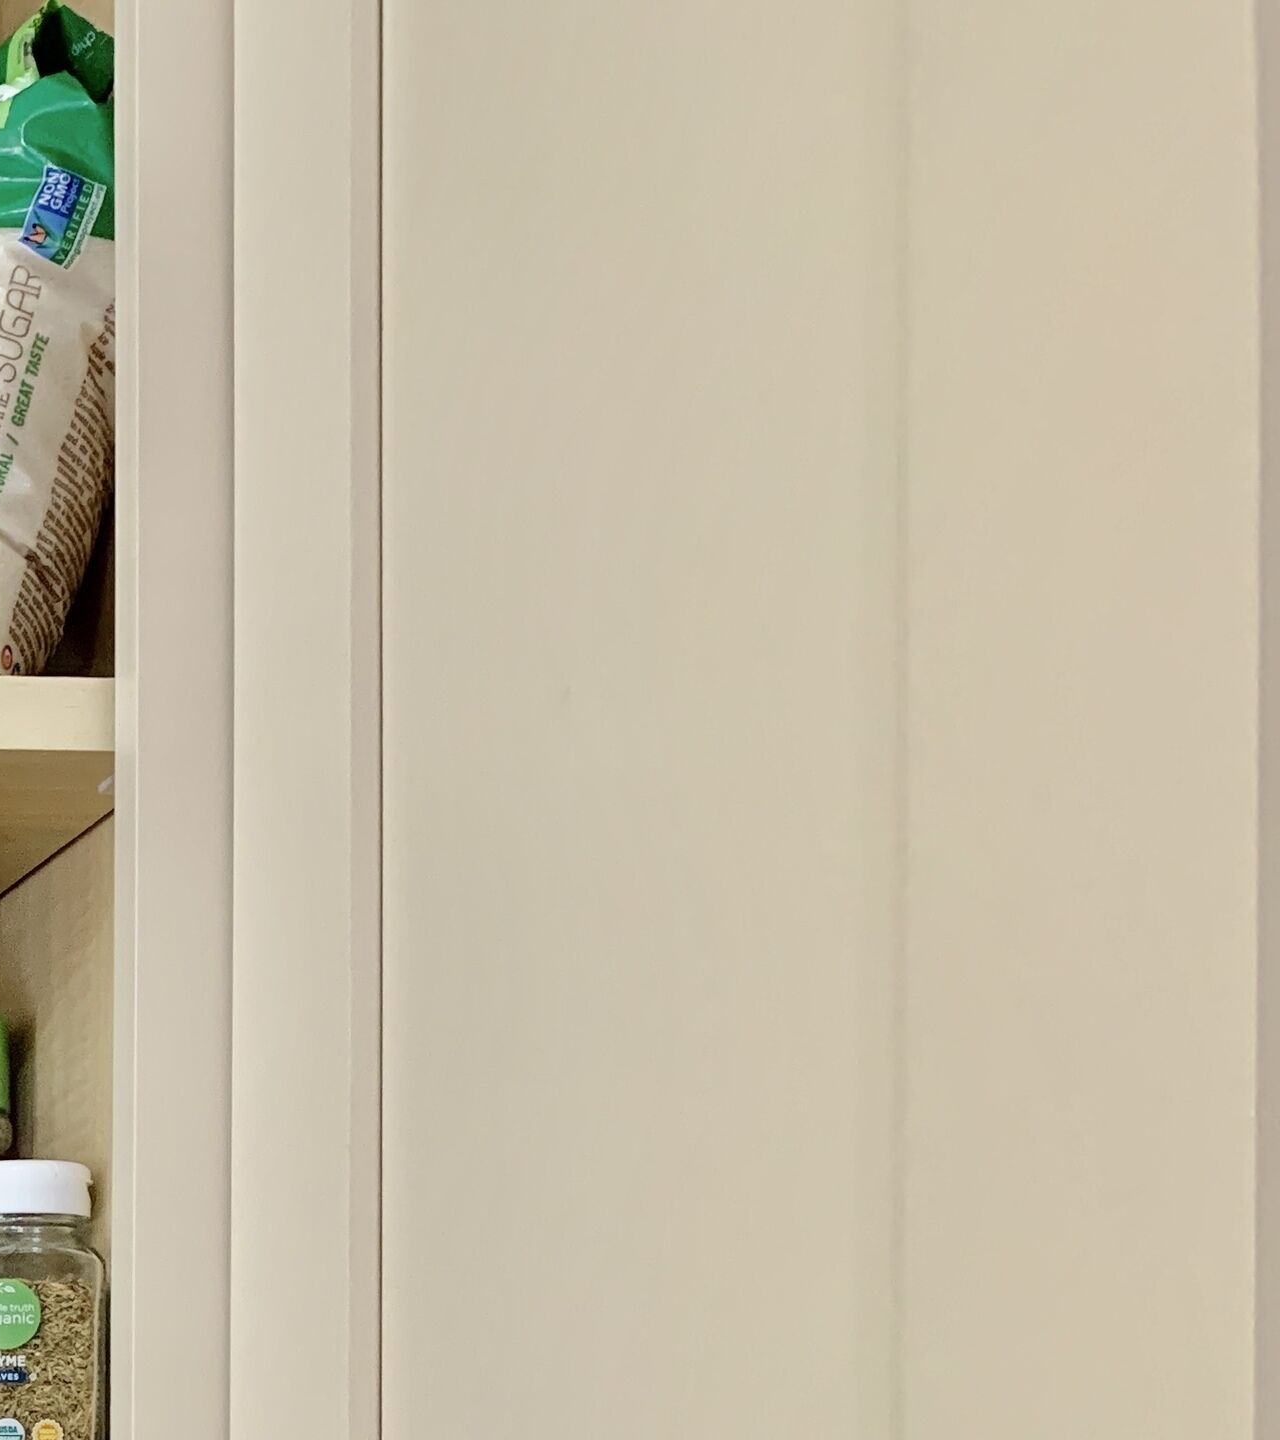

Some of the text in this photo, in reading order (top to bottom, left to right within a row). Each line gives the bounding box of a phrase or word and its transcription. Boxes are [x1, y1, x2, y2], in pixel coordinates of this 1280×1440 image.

[39, 172, 59, 206] NON
[50, 173, 71, 210] GMO
[56, 184, 92, 260] VERIFIED
[11, 379, 35, 428] GREAT
[26, 332, 50, 380] TASTE
[10, 1304, 34, 1312] truth
